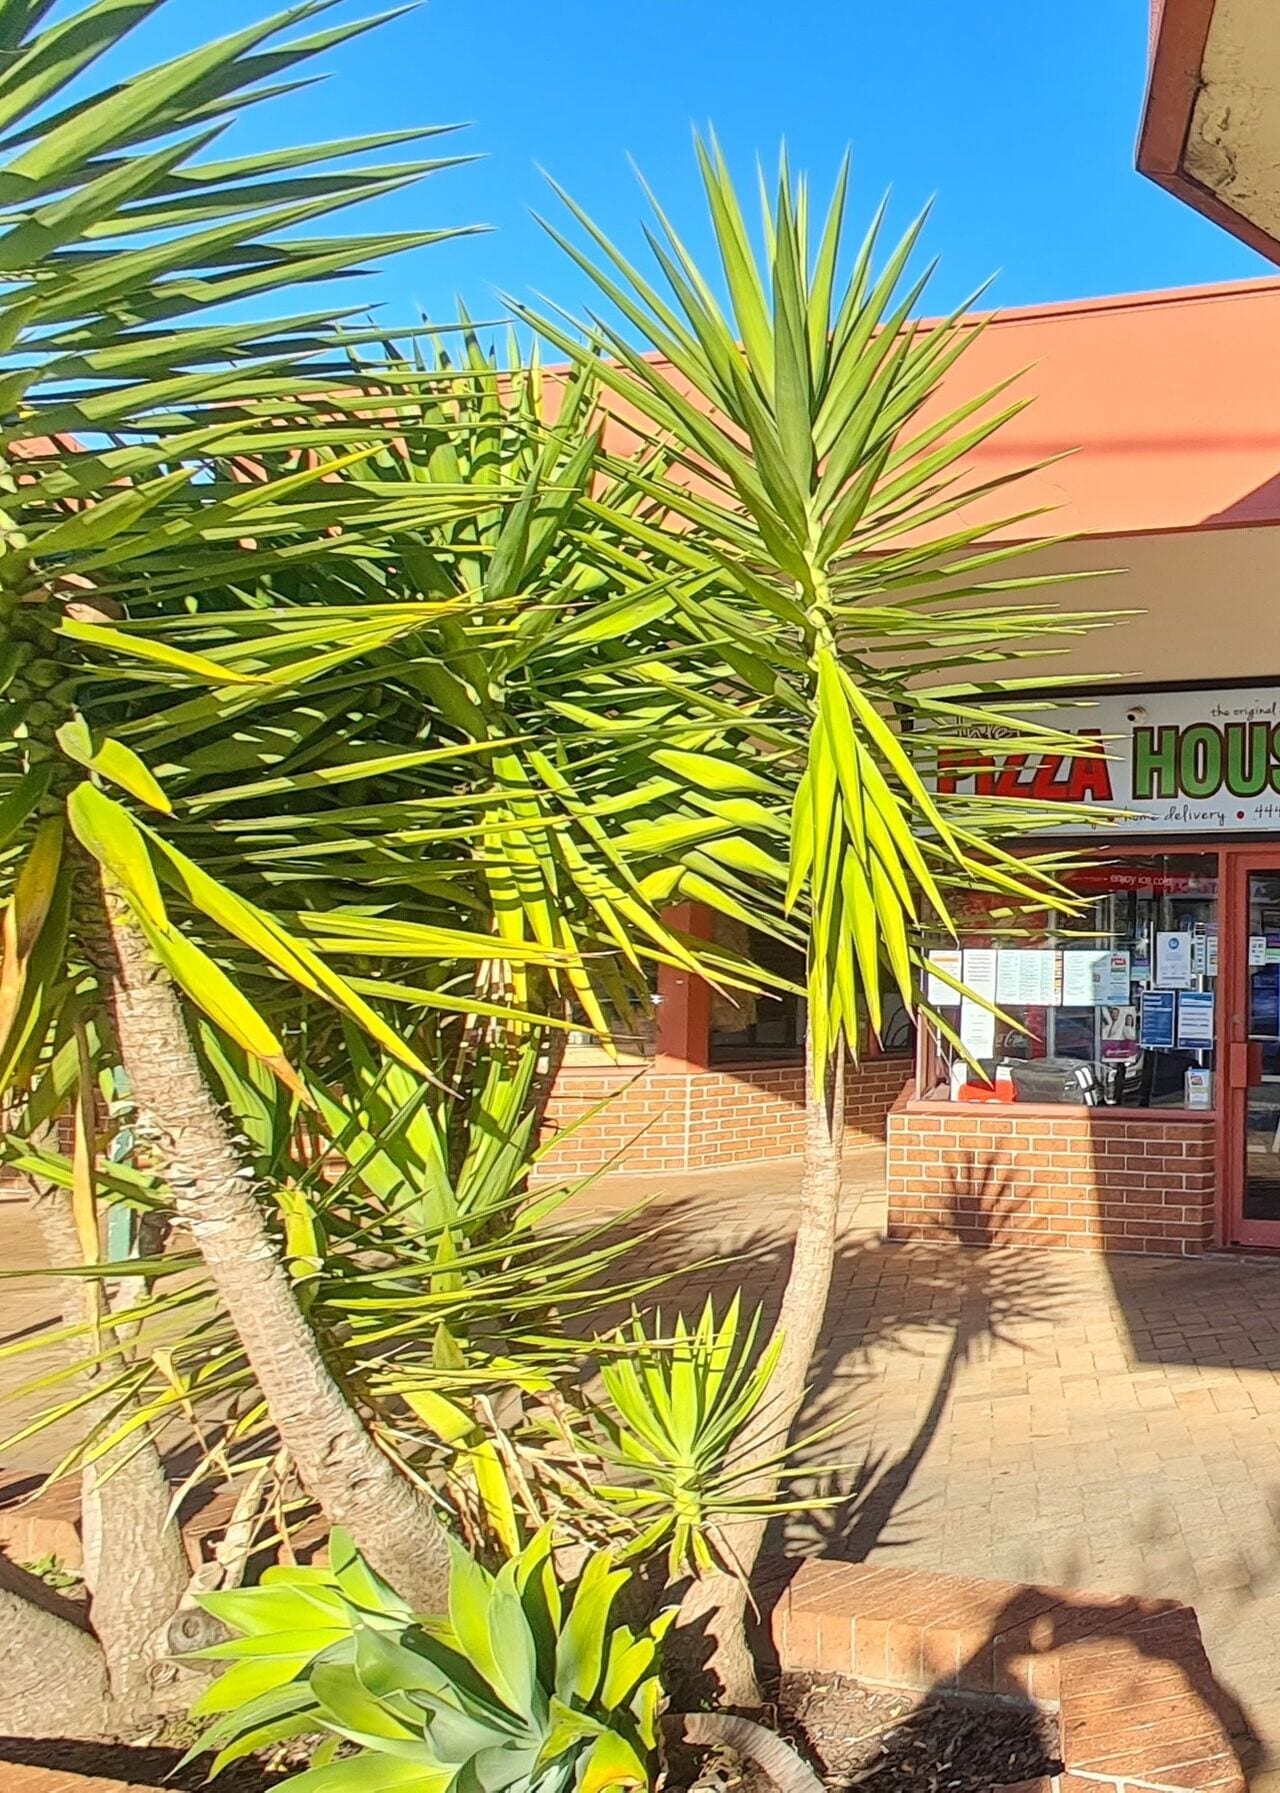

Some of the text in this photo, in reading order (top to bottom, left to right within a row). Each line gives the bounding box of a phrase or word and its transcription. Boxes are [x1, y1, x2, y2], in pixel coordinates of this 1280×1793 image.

[1210, 704, 1231, 718] the
[1233, 702, 1277, 720] original
[937, 727, 1114, 802] PIZZA
[1164, 805, 1226, 825] delivery
[1110, 874, 1136, 886] enjoy
[1138, 874, 1152, 885] ice
